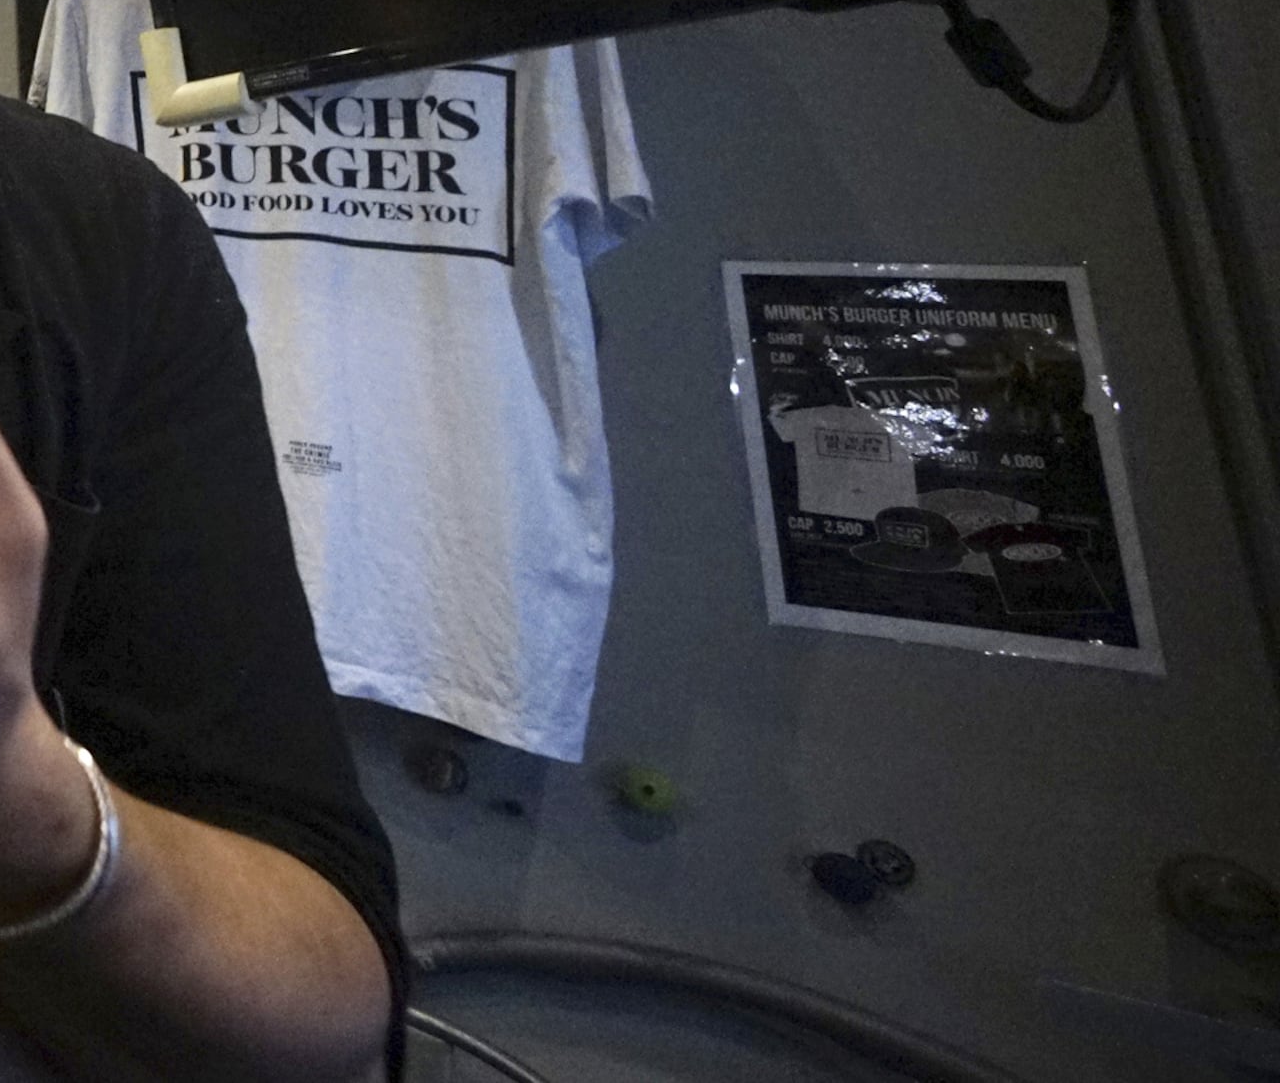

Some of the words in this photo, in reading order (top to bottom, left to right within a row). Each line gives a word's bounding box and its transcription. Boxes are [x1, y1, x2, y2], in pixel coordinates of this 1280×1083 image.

[169, 95, 480, 141] UNCH'S
[180, 143, 467, 195] BURGER
[243, 194, 313, 212] FOOD
[321, 197, 412, 221] LOVES
[420, 205, 480, 226] YOU
[764, 304, 839, 322] MUNCH'S
[843, 306, 911, 325] BURGER
[915, 309, 997, 327] UNIFORM
[1001, 311, 1057, 330] MENU
[770, 351, 796, 365] CAP
[787, 517, 814, 530] CAP
